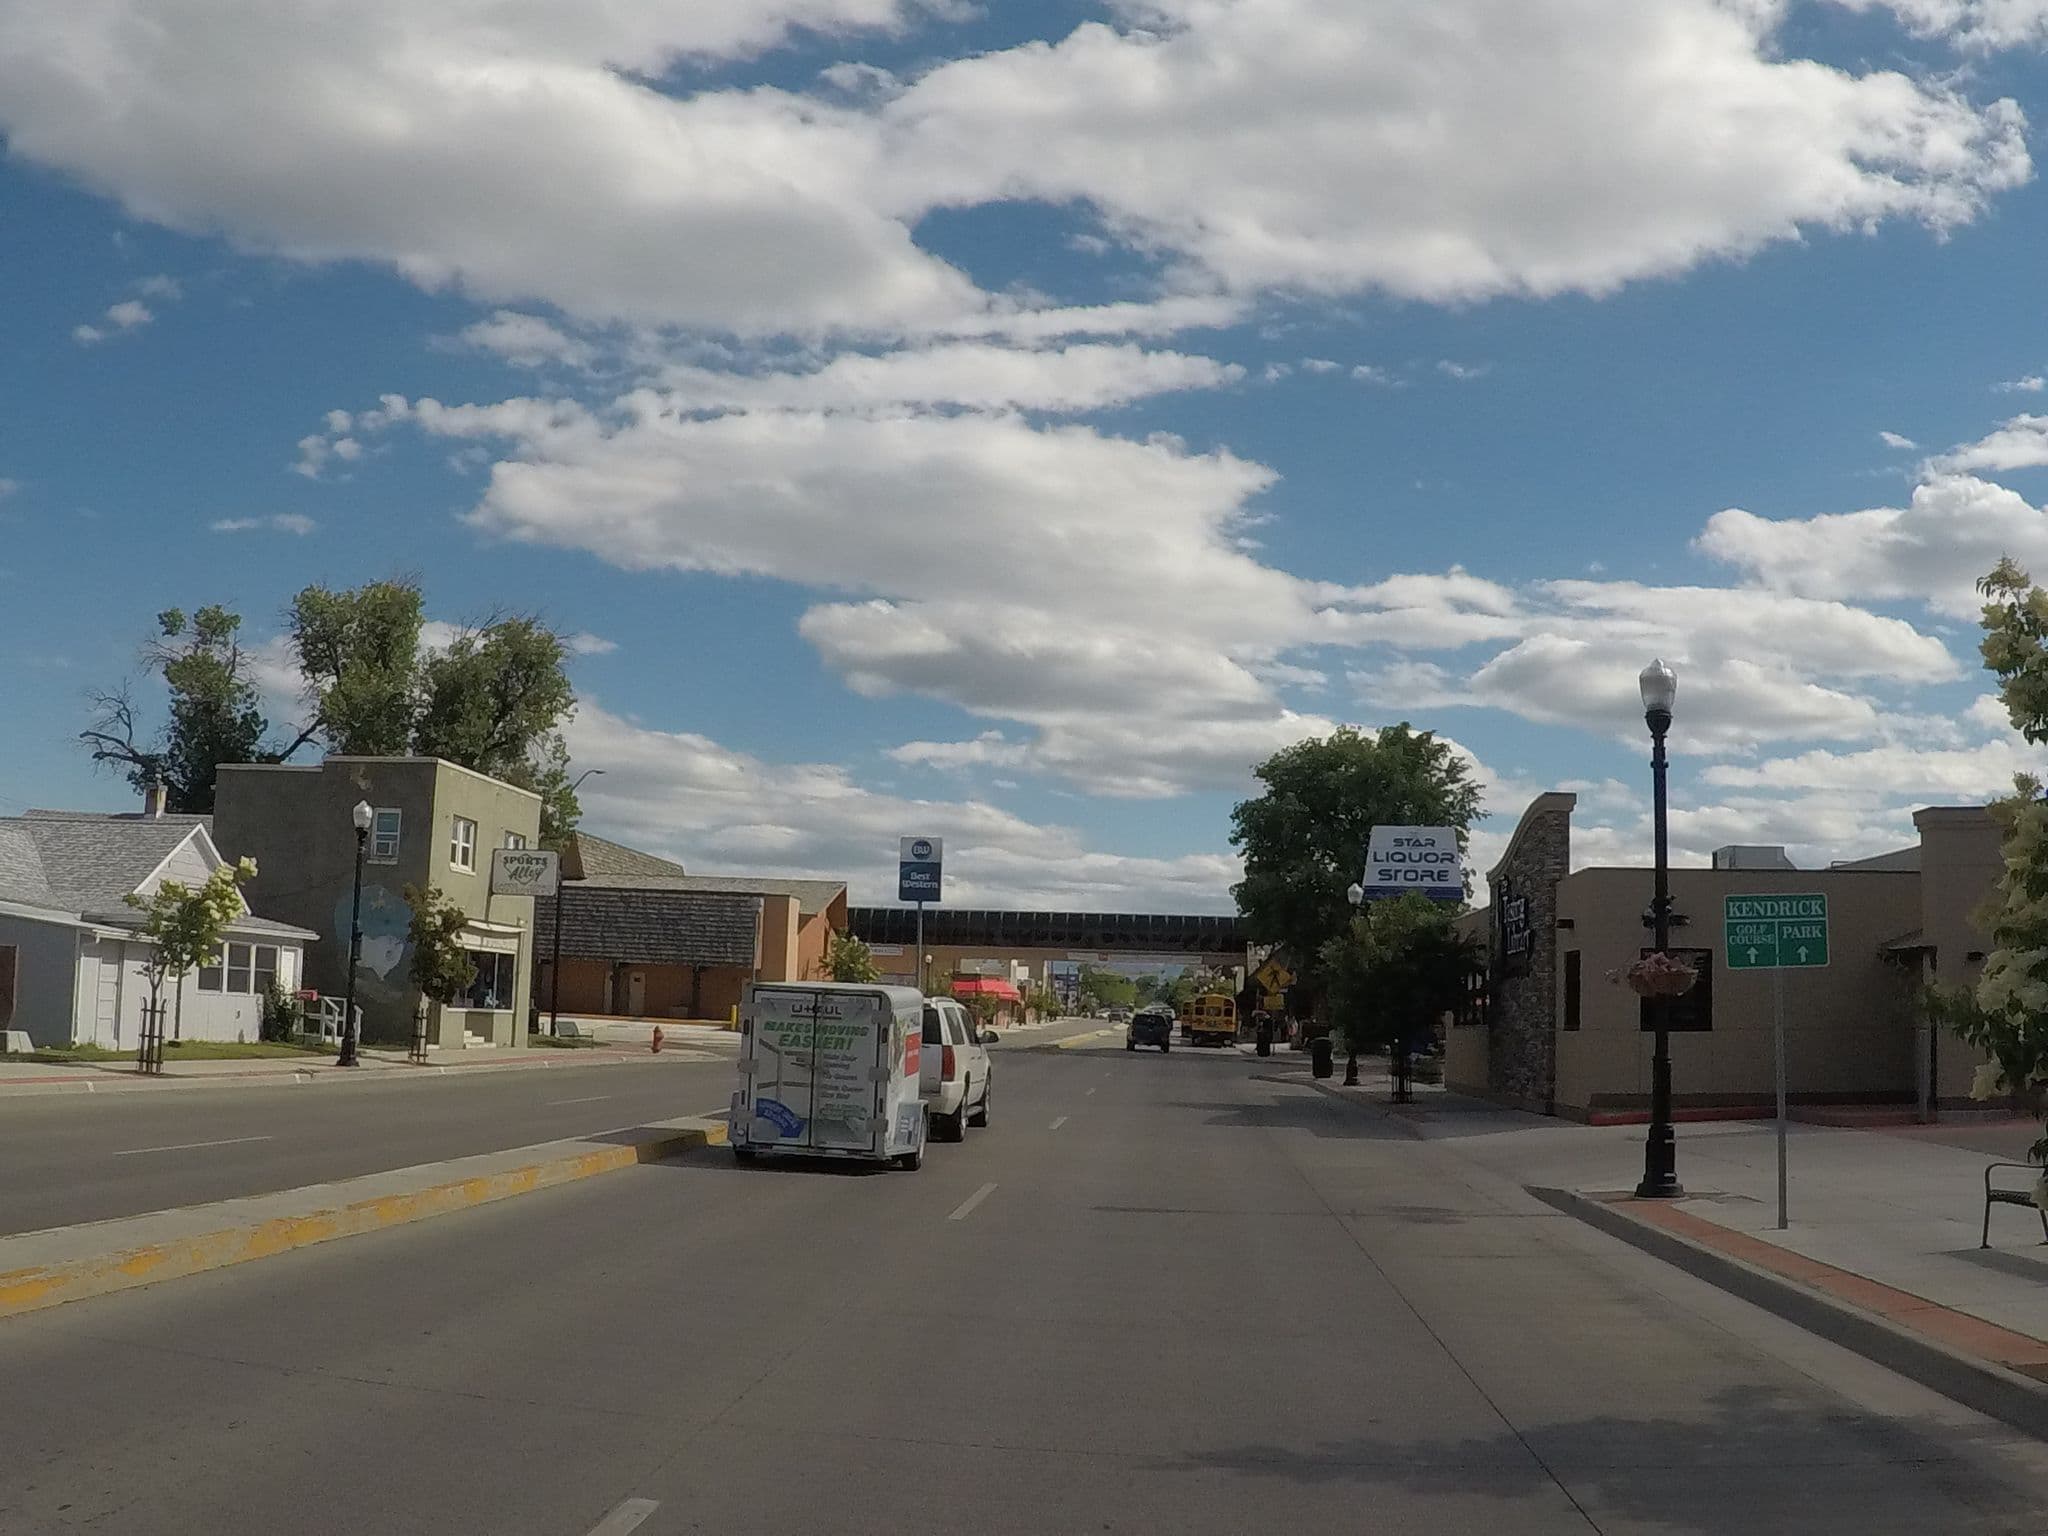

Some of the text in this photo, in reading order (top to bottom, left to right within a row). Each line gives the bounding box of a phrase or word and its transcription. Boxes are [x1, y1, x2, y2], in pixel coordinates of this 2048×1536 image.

[1393, 838, 1436, 847] STAR
[913, 846, 930, 855] BW
[503, 856, 548, 866] SPORTS
[1373, 852, 1455, 864] LIQUOR
[509, 866, 544, 881] Alley
[910, 872, 931, 880] Best
[1378, 869, 1449, 881] STORE
[902, 880, 938, 888] Western
[1728, 900, 1823, 917] KENDRICK
[1736, 924, 1768, 935] GOLF
[1782, 925, 1822, 939] PARK
[1729, 934, 1774, 945] COURSE
[764, 1021, 869, 1037] MAKES MOVING
